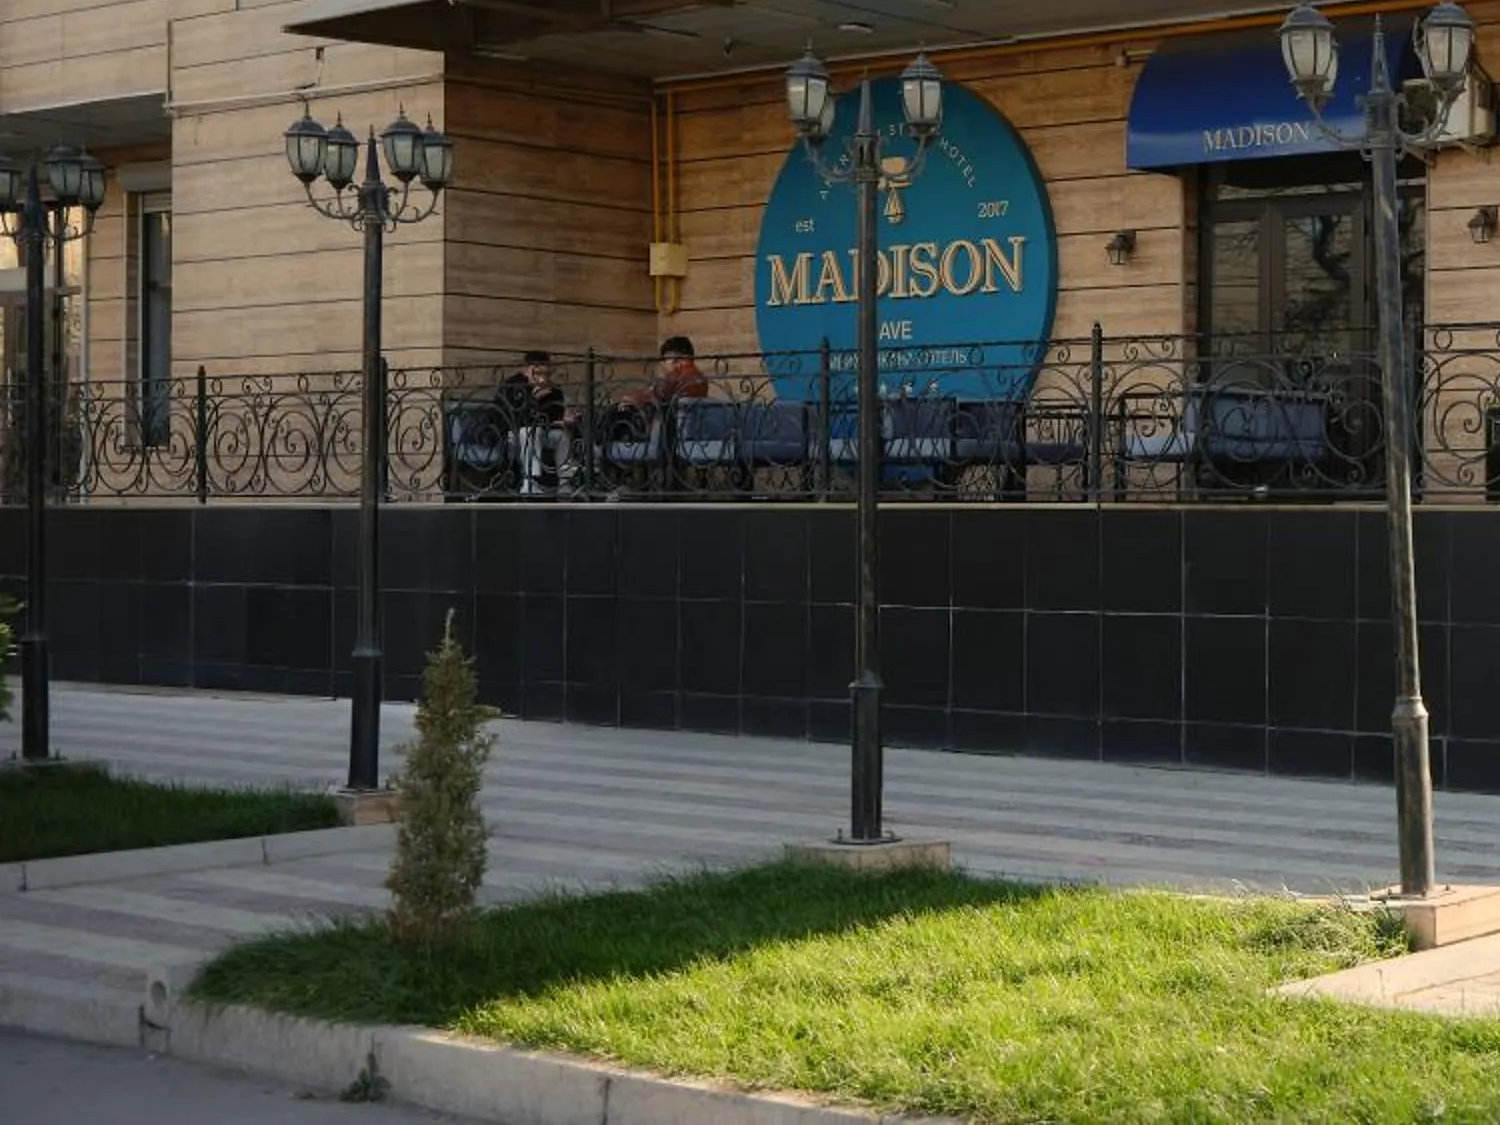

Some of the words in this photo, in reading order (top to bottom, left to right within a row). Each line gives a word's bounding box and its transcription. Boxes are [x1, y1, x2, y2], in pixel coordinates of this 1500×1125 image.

[1203, 121, 1310, 154] MADISON
[978, 200, 1009, 218] 2017
[766, 236, 1027, 306] MADISON
[880, 320, 913, 340] AVE
